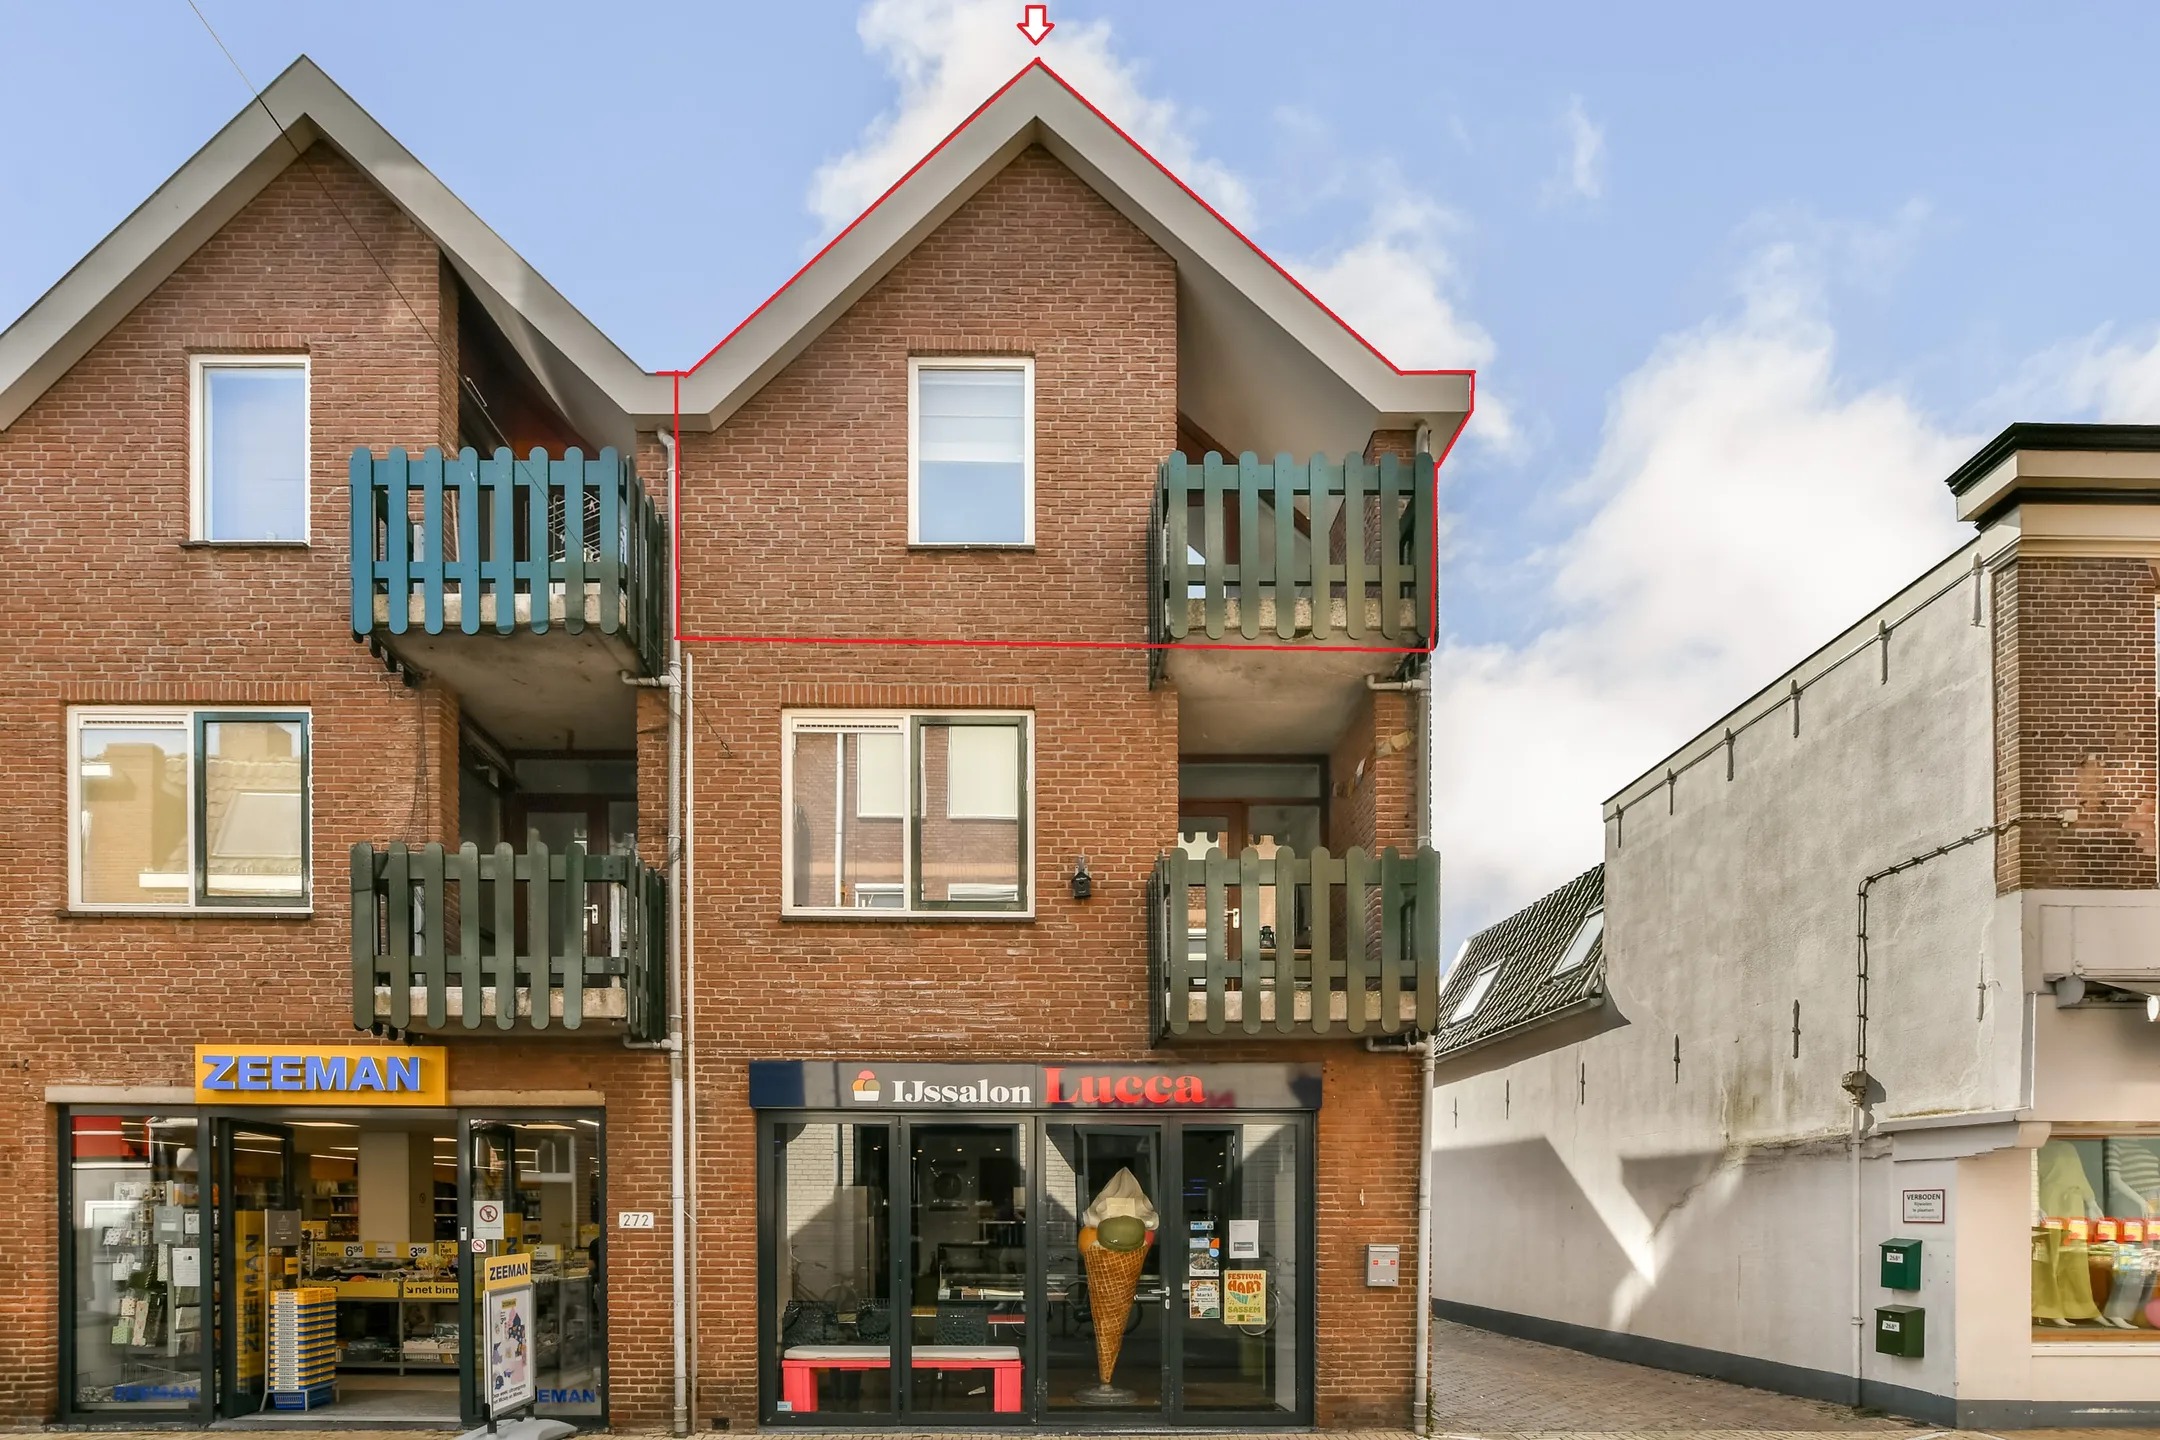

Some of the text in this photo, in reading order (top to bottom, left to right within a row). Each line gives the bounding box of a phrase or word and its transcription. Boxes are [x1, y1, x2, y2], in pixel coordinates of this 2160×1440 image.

[203, 1056, 421, 1091] ZEEMAN
[892, 1066, 1207, 1104] IJssalon Lucca
[1906, 1193, 1941, 1201] VERBODEN
[623, 1214, 649, 1226] 272
[490, 1262, 528, 1281] ZEEMAN
[415, 1286, 433, 1294] net
[1227, 1280, 1262, 1294] HART
